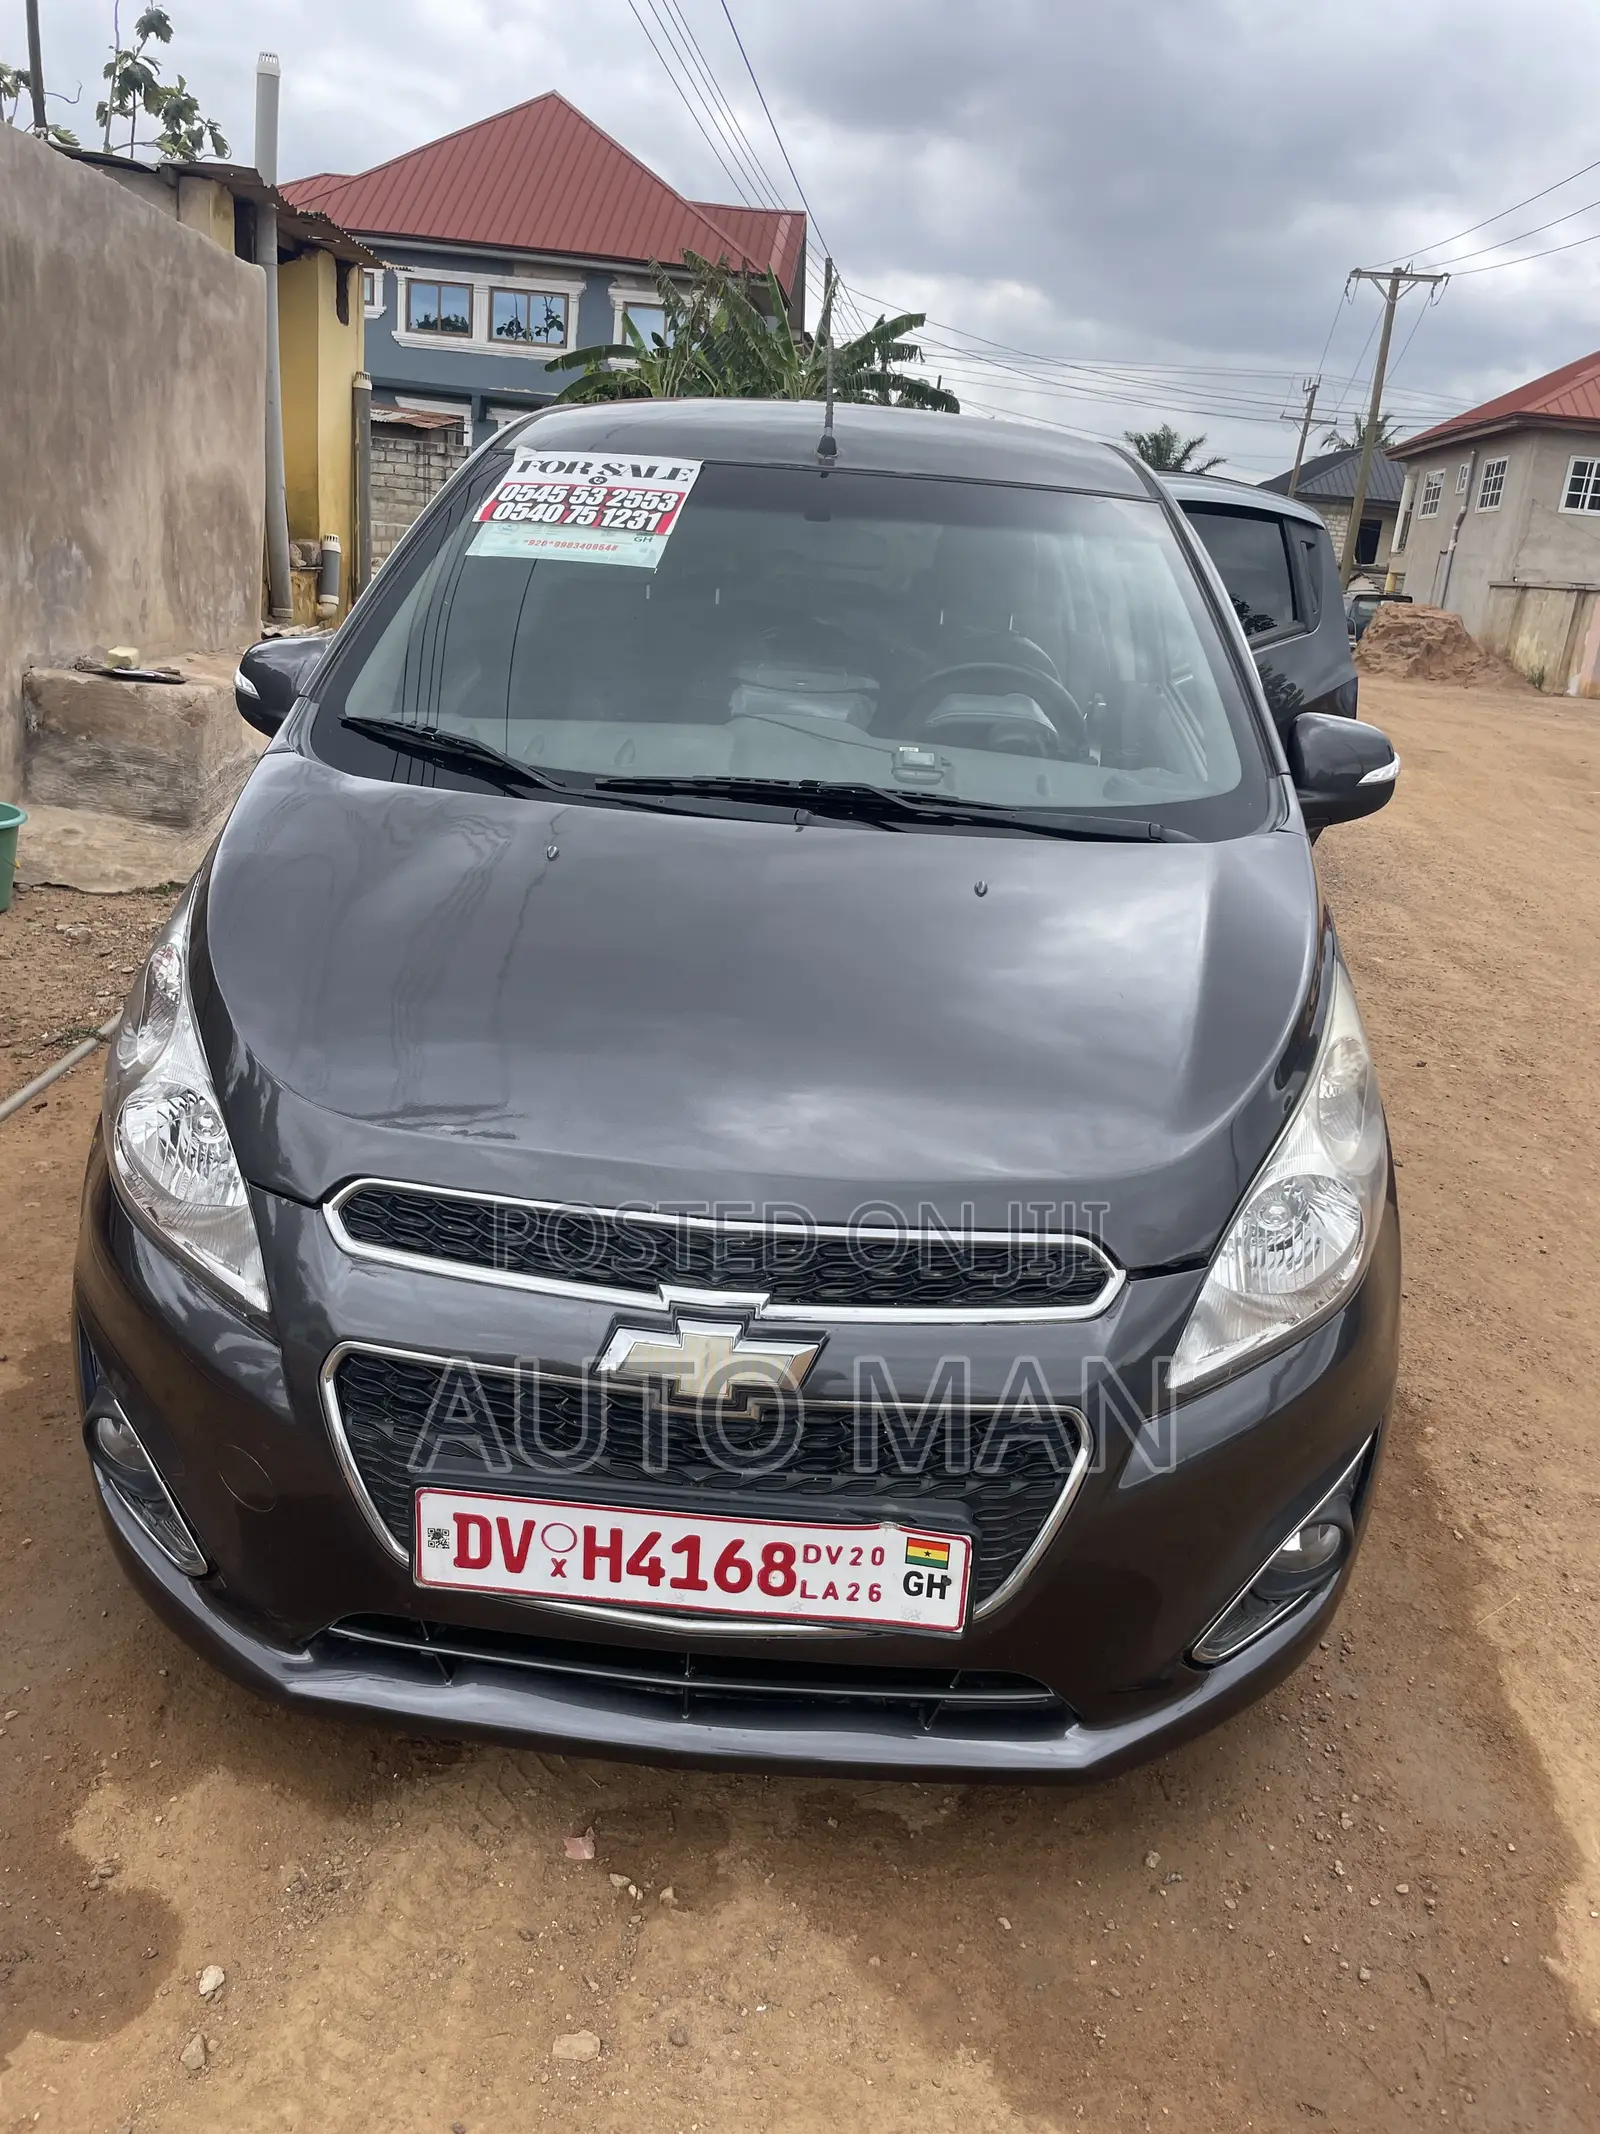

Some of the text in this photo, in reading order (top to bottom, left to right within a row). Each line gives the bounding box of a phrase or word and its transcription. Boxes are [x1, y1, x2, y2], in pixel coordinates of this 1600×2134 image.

[516, 460, 695, 482] FOR SALE
[498, 483, 679, 512] 0545 53 2553
[492, 501, 663, 532] 0540 75 1231
[453, 1512, 536, 1574] DV
[583, 1525, 797, 1597] H4168
[902, 1570, 950, 1600] GH
